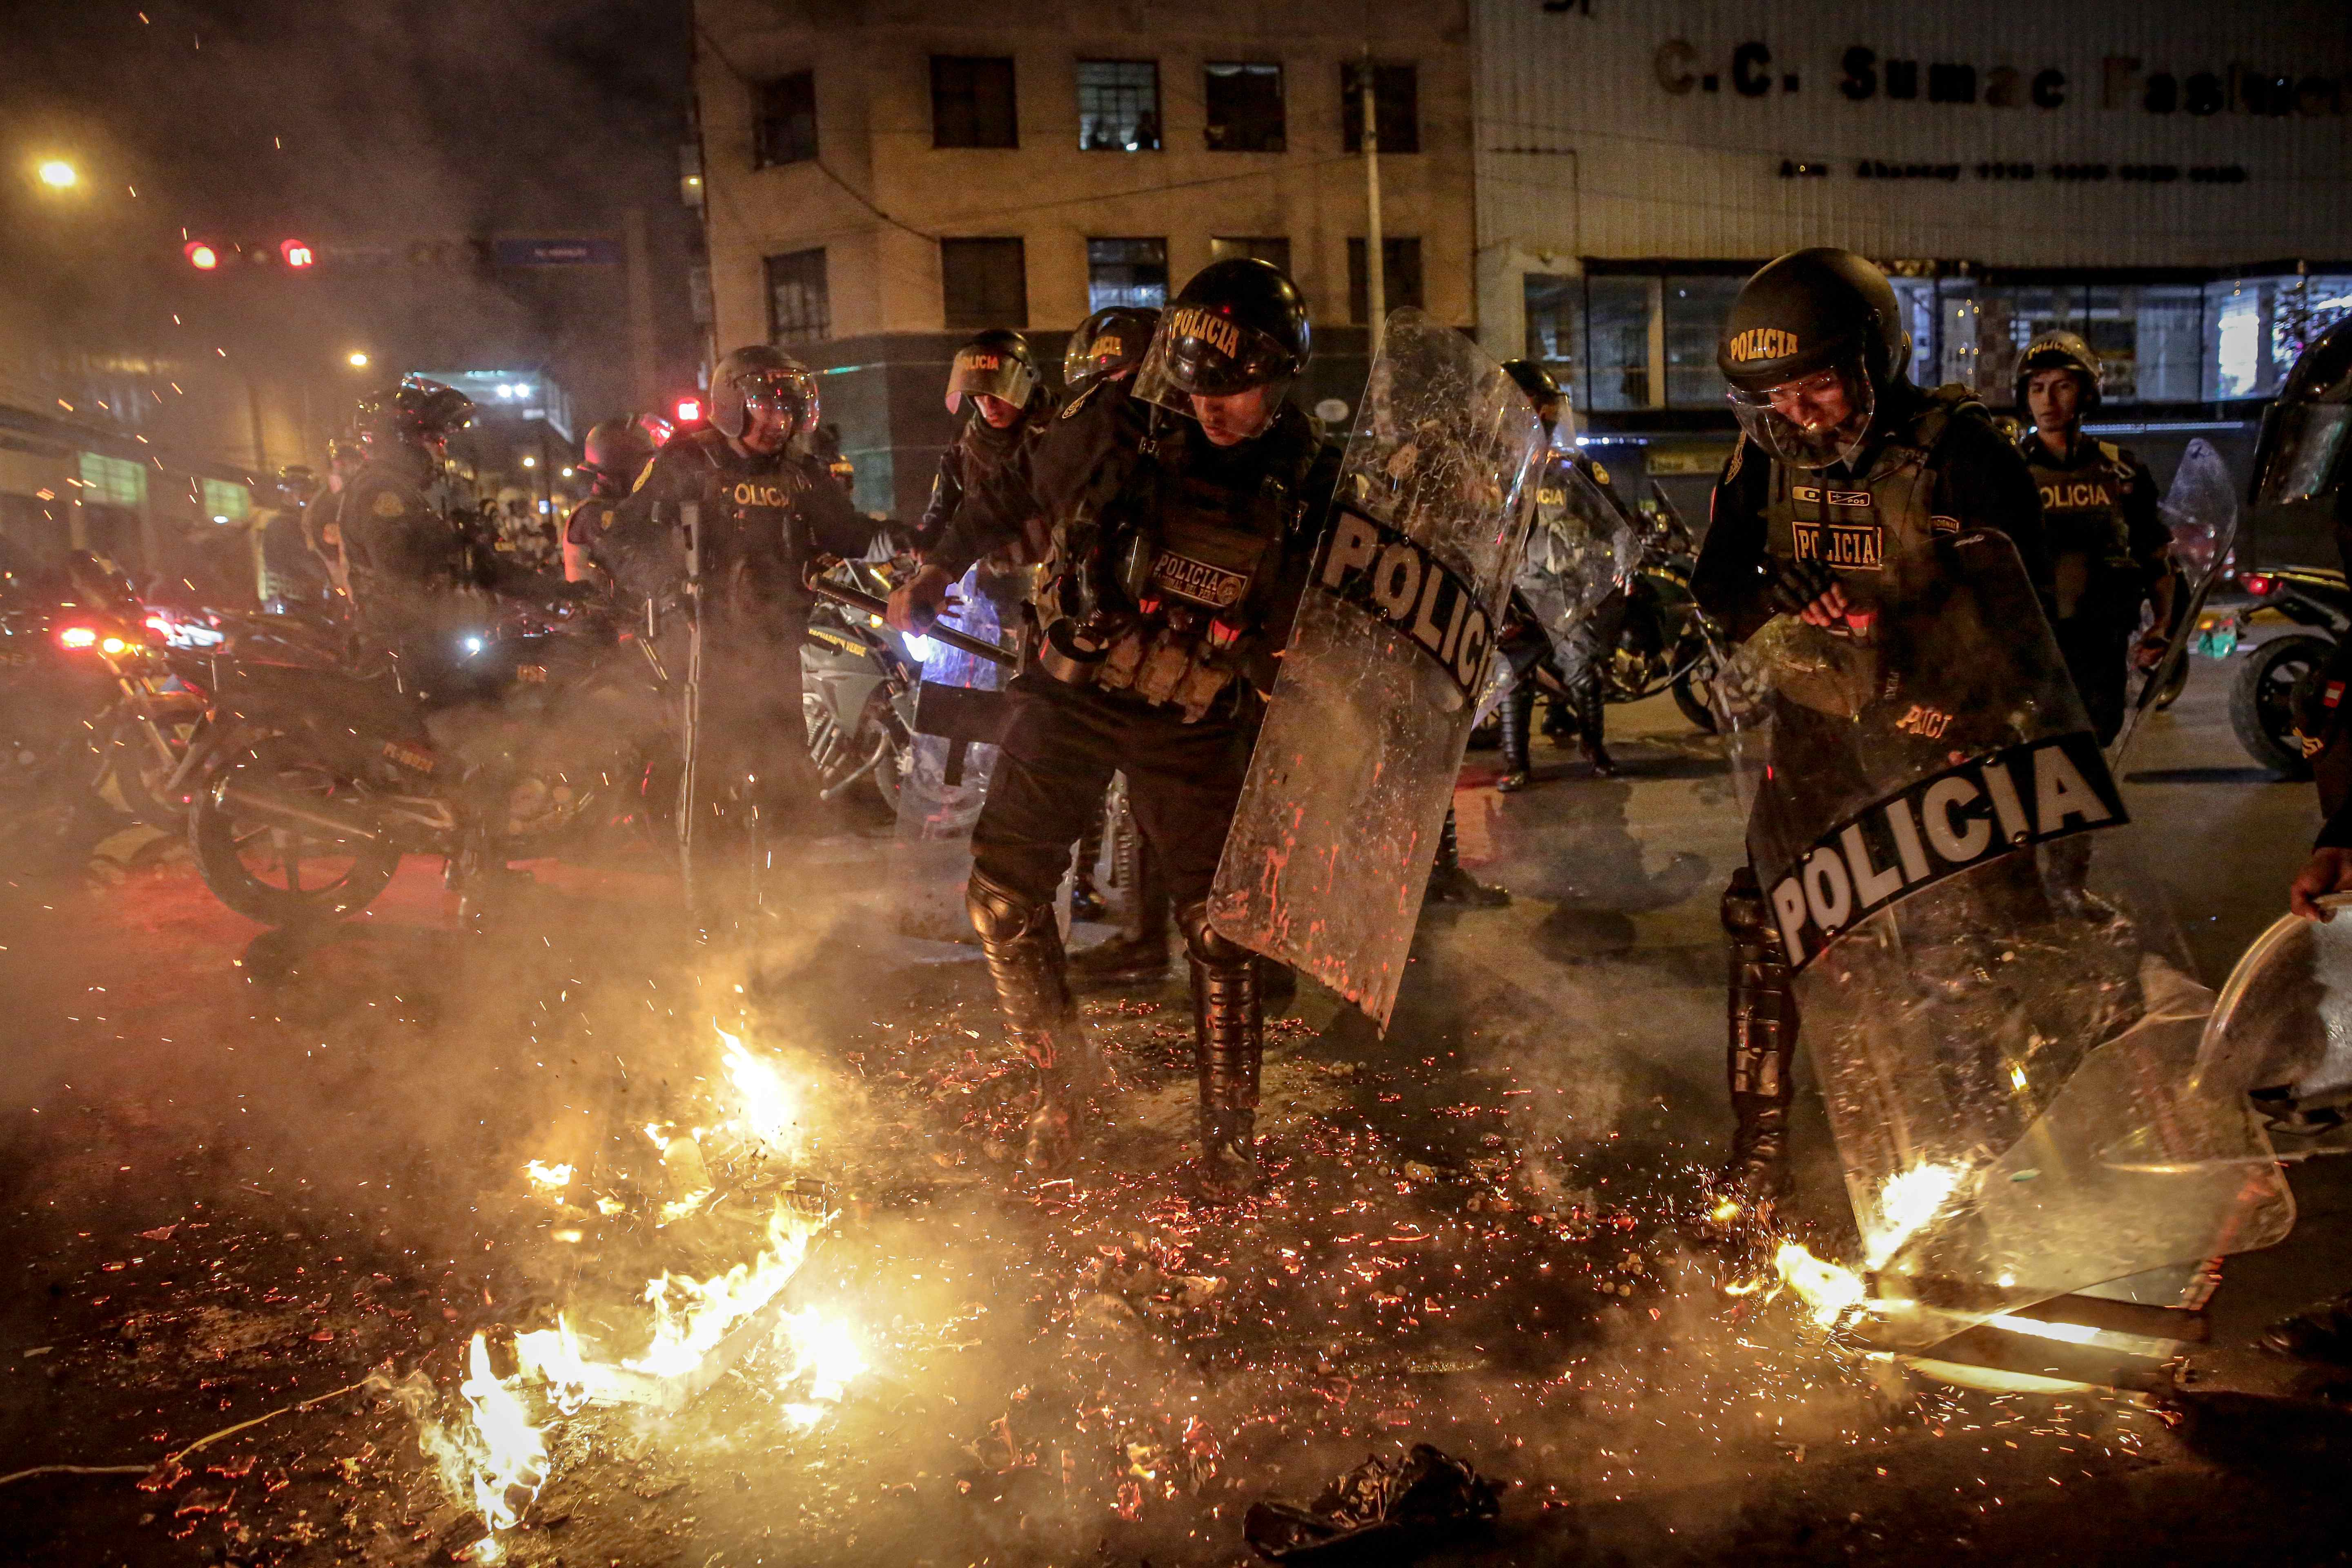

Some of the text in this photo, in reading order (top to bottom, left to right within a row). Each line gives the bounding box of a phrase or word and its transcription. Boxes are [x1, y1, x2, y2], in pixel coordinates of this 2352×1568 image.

[1654, 40, 1799, 99] C.C.
[1840, 45, 2065, 110] Sumac
[1172, 309, 1240, 359] POLICIA
[1730, 328, 1798, 362] POLICIA
[2039, 484, 2111, 509] OLICIA
[1798, 530, 1875, 564] POICIA
[1154, 554, 1220, 591] POLICIA
[1322, 510, 1492, 698] POLICI
[1771, 745, 2114, 967] POLICIA
